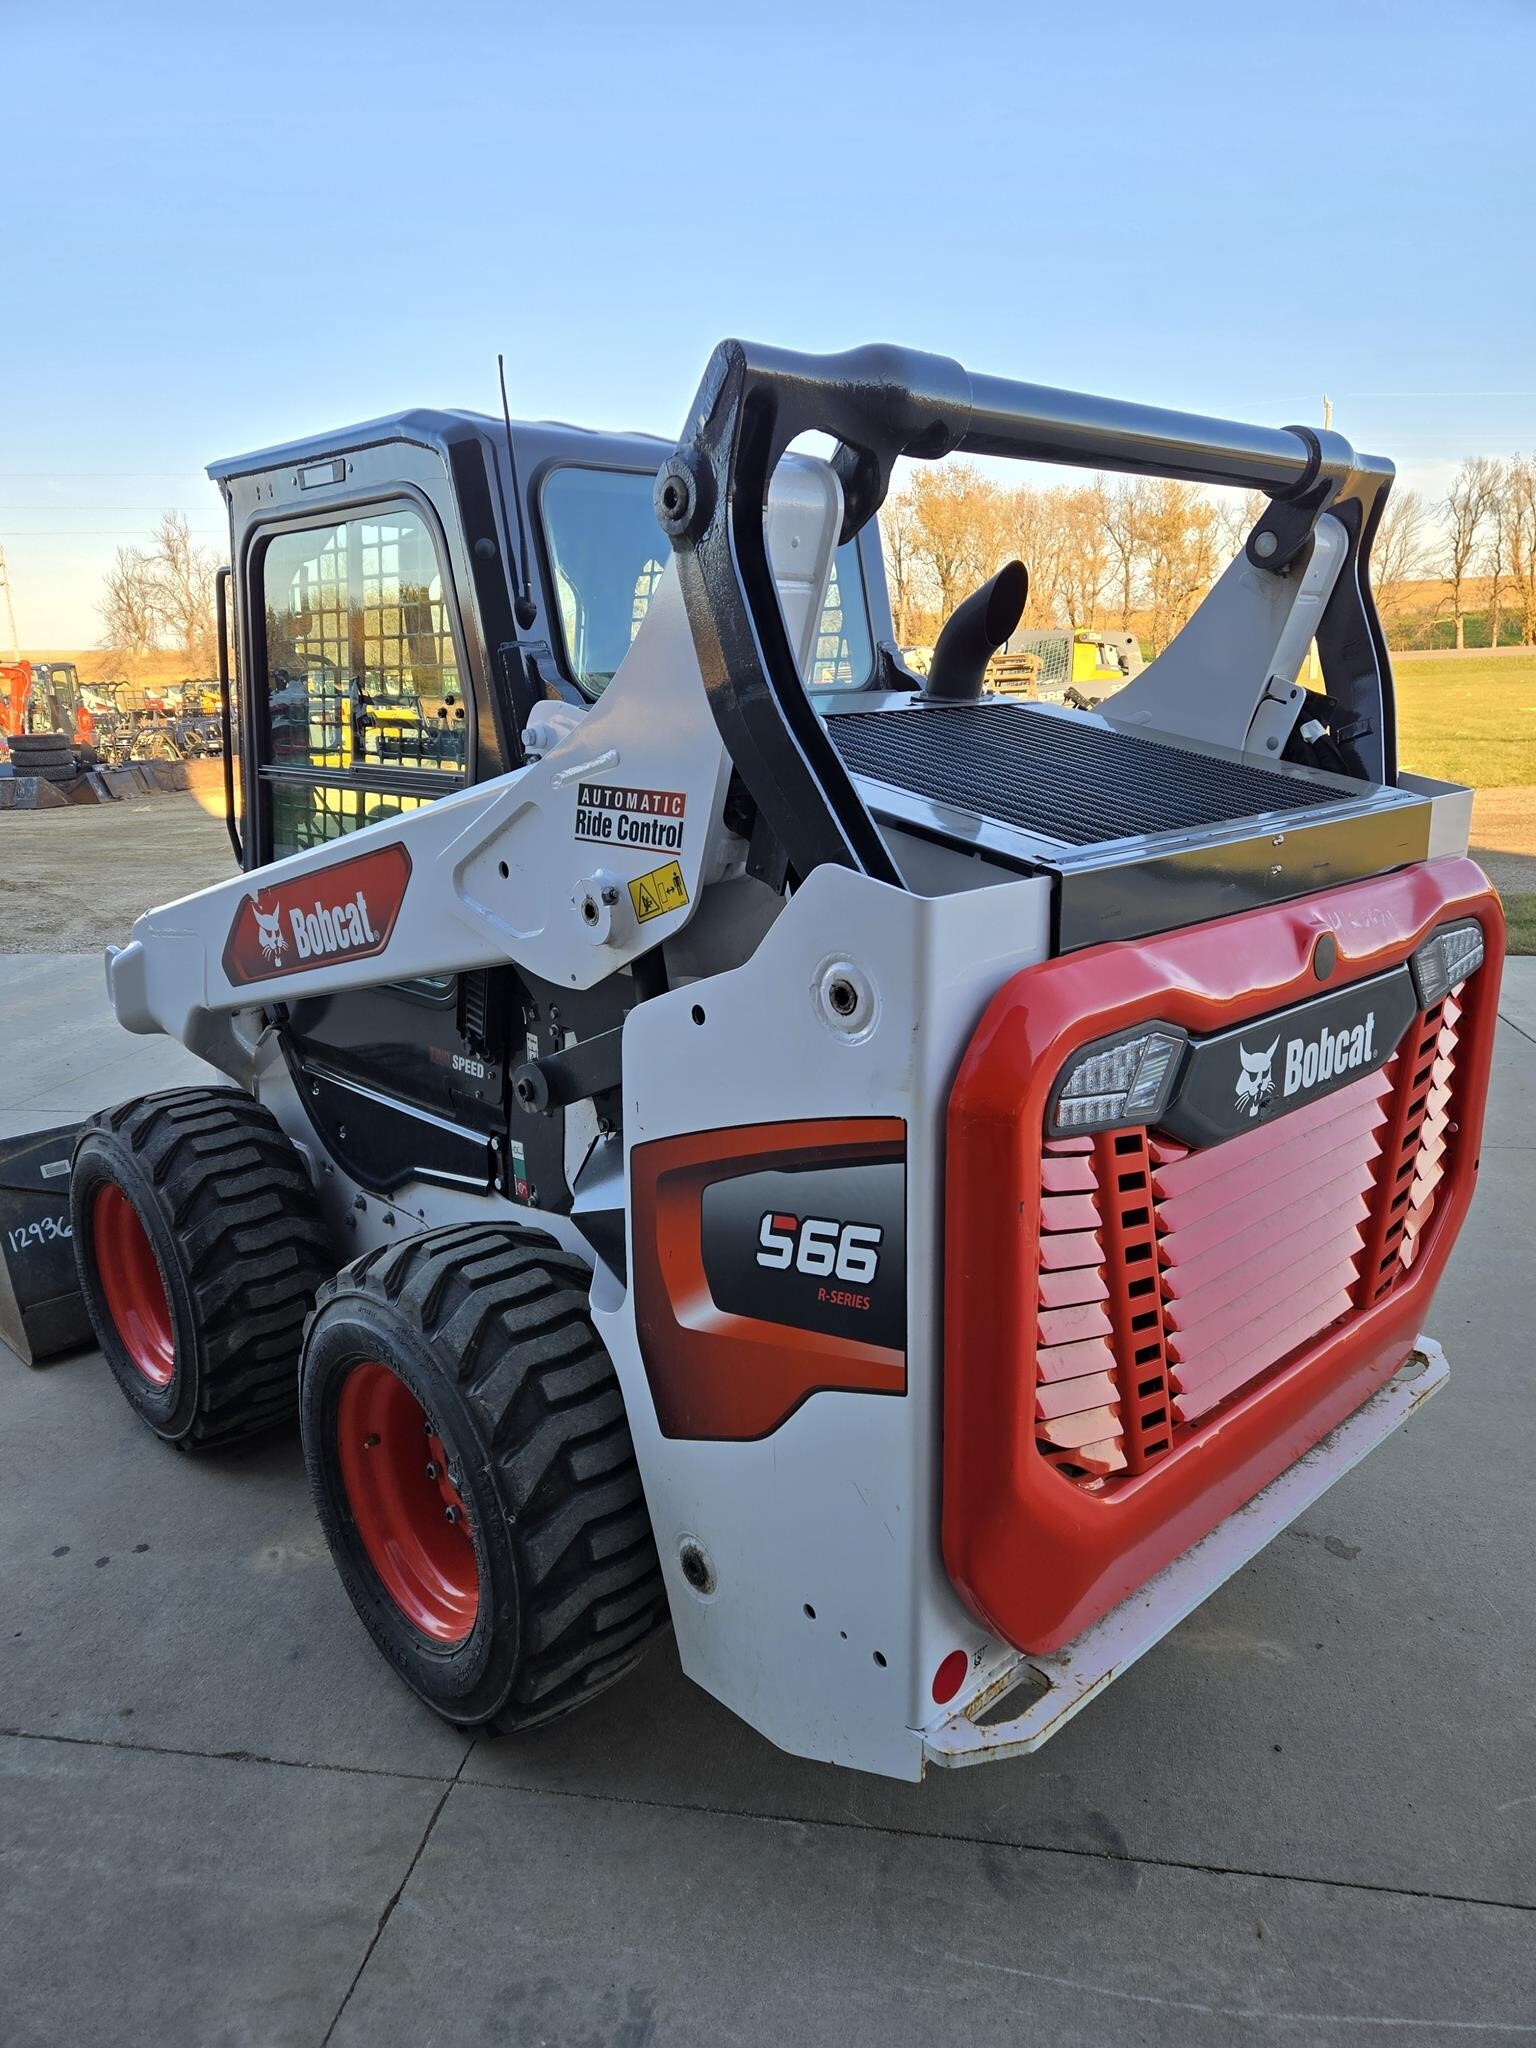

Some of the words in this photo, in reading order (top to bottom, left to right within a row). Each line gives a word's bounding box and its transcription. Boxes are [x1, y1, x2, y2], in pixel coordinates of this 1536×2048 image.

[581, 787, 681, 815] AUTOMATIC
[575, 808, 612, 838] Ride
[617, 813, 684, 848] Control
[288, 891, 375, 959] Bobcat
[452, 1054, 484, 1078] SPEED
[1283, 1011, 1375, 1098] Bobcat
[756, 1213, 882, 1284] S66
[817, 1287, 871, 1310] R-SERIES
